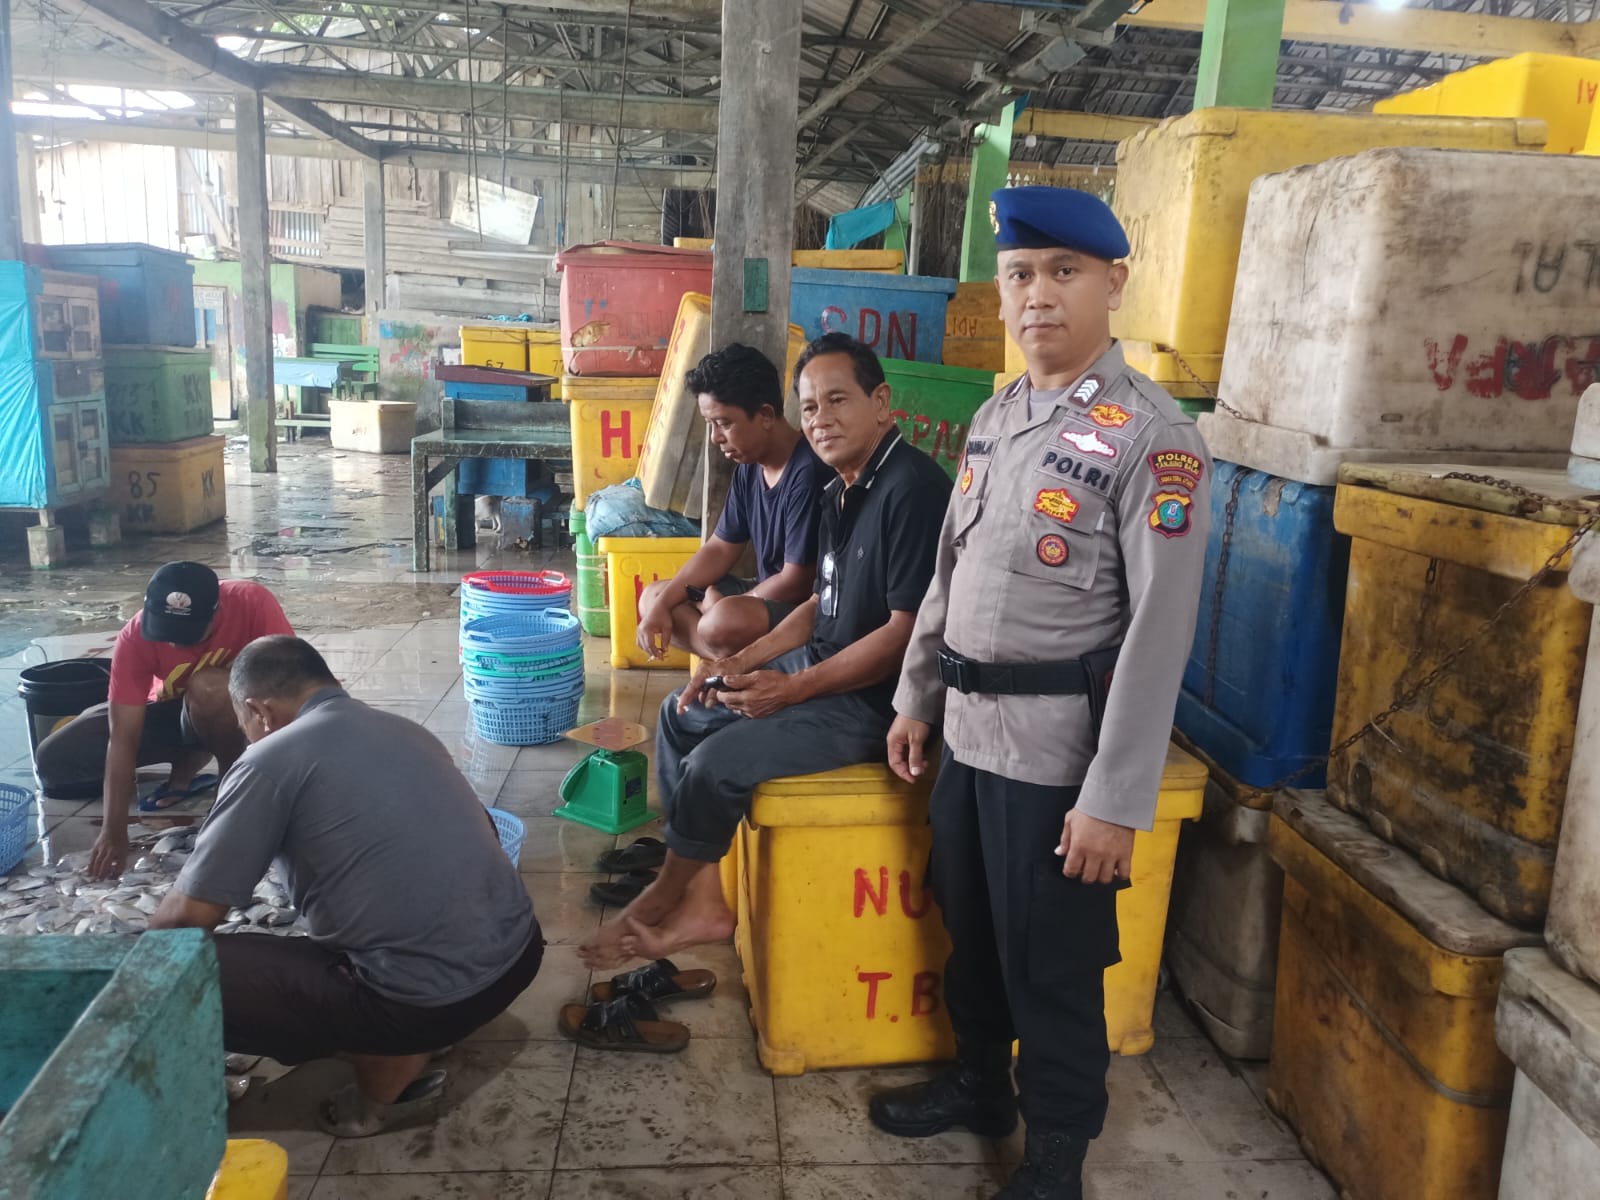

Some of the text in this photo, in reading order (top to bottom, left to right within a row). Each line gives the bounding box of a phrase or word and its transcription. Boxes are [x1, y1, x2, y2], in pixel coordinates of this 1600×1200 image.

[946, 316, 978, 338] ADI
[1042, 451, 1110, 490] POLRI
[1157, 453, 1199, 468] POLRES
[128, 470, 160, 499] 85
